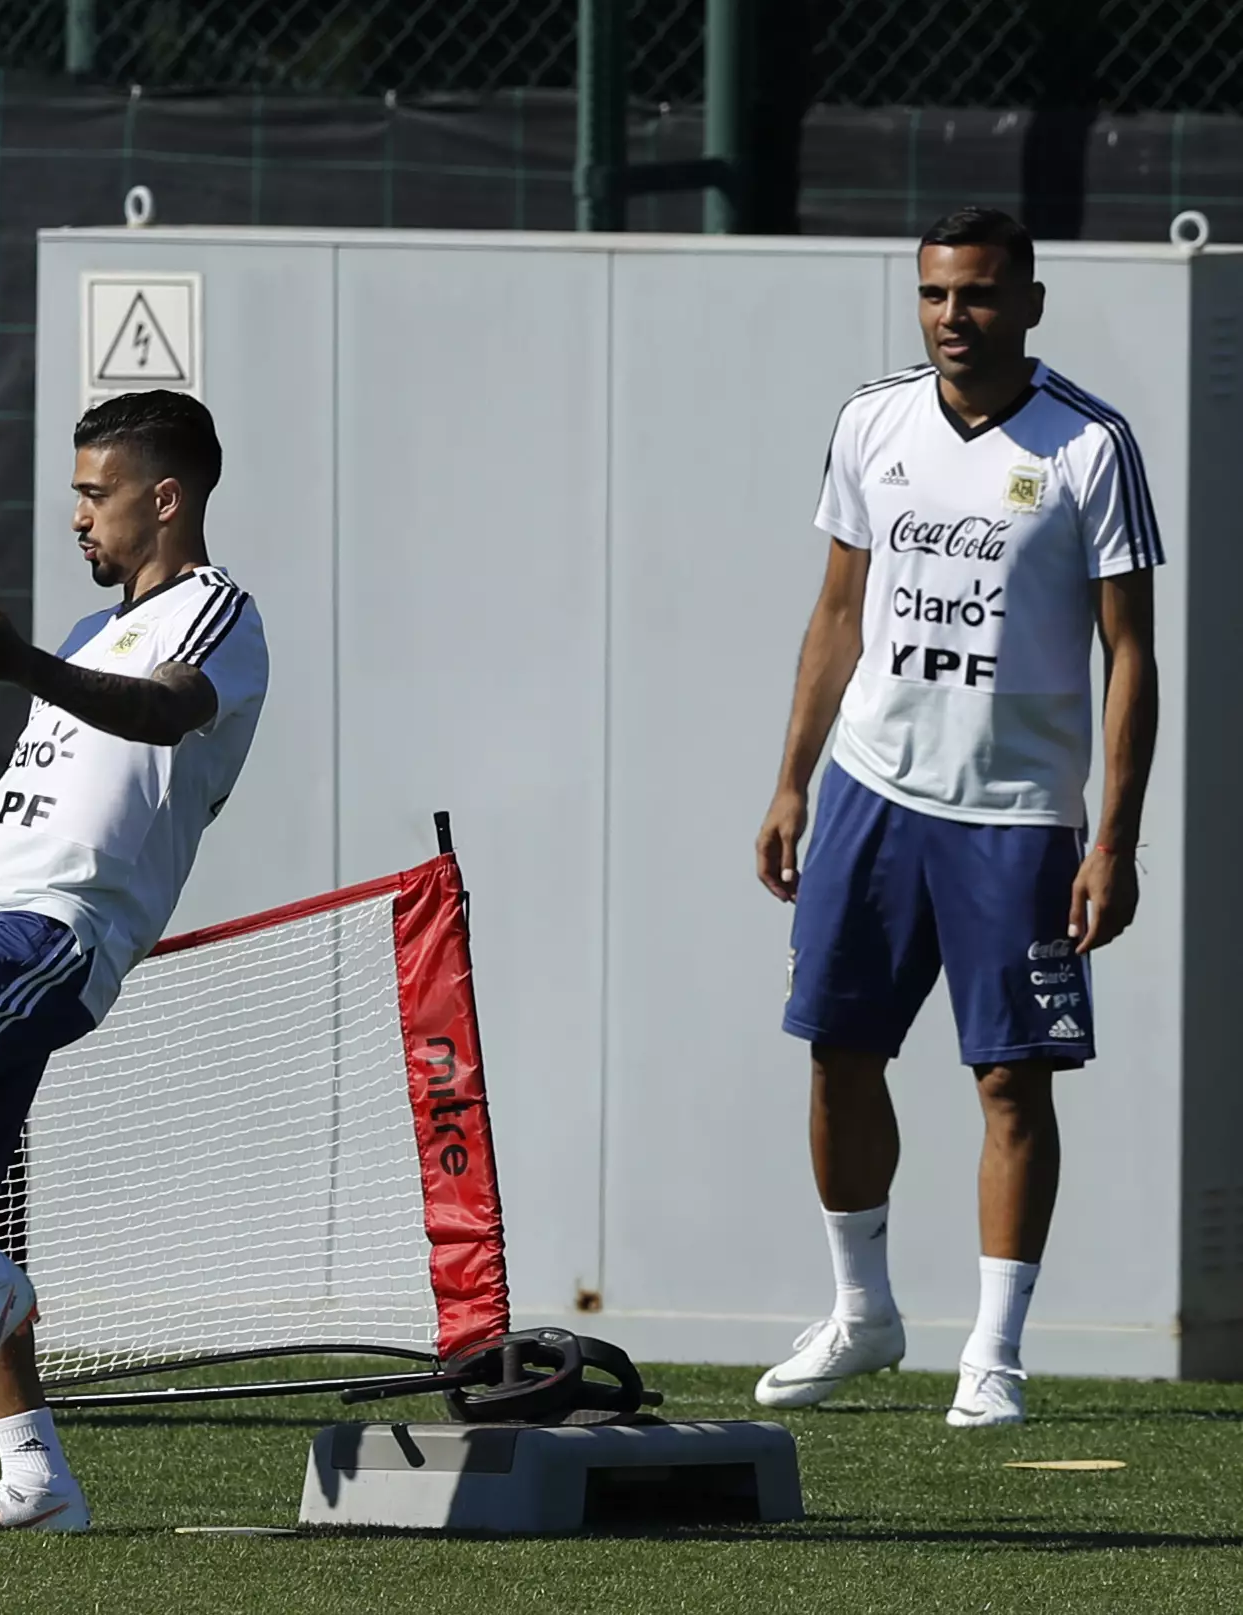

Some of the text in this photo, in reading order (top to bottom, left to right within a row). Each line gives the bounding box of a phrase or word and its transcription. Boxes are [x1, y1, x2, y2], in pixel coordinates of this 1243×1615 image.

[889, 509, 1013, 562] Coca-Cola
[893, 585, 986, 627] Claro
[890, 640, 998, 687] YPF
[1033, 992, 1081, 1010] YPF
[426, 1036, 469, 1178] mitre
